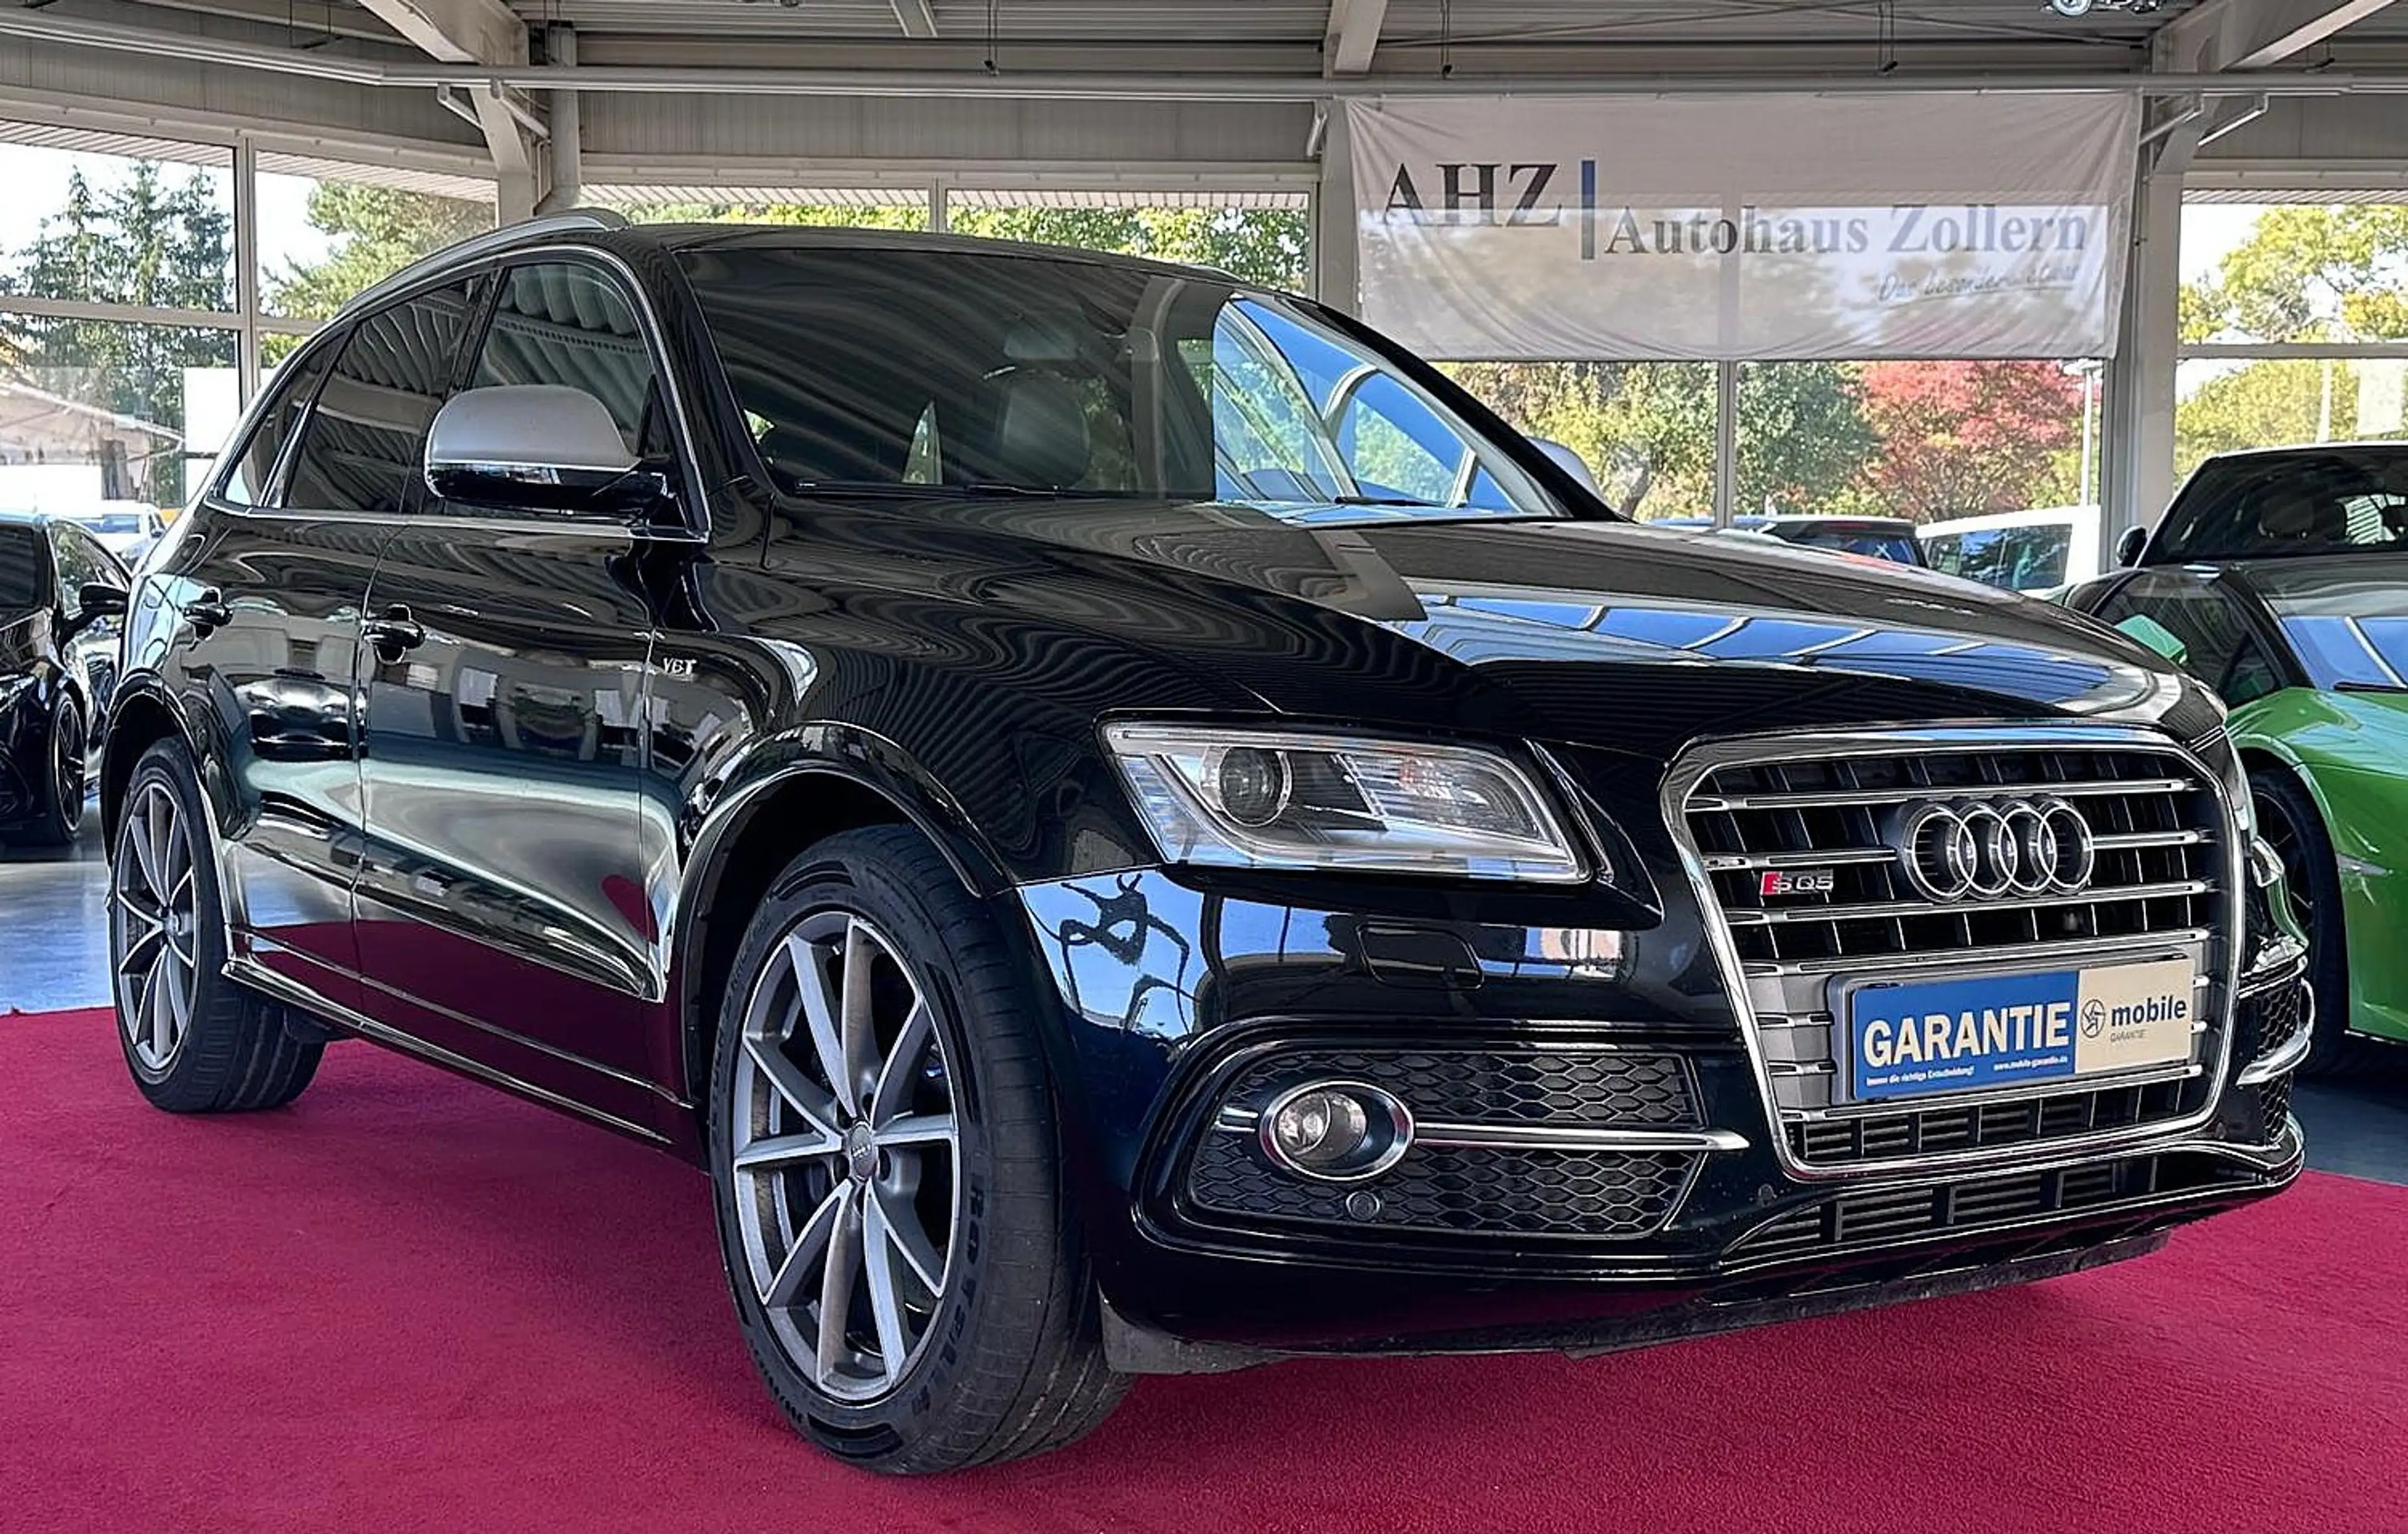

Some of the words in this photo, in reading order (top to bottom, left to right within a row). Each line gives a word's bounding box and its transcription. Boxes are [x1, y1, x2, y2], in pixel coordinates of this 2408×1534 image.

[1382, 162, 1561, 227] AHZ
[1604, 204, 1869, 254] Autohaus
[1887, 203, 2086, 252] Zollern
[1771, 873, 1834, 893] SQ5
[1864, 1002, 2071, 1068] GARANTIE
[2111, 994, 2187, 1027] mobile
